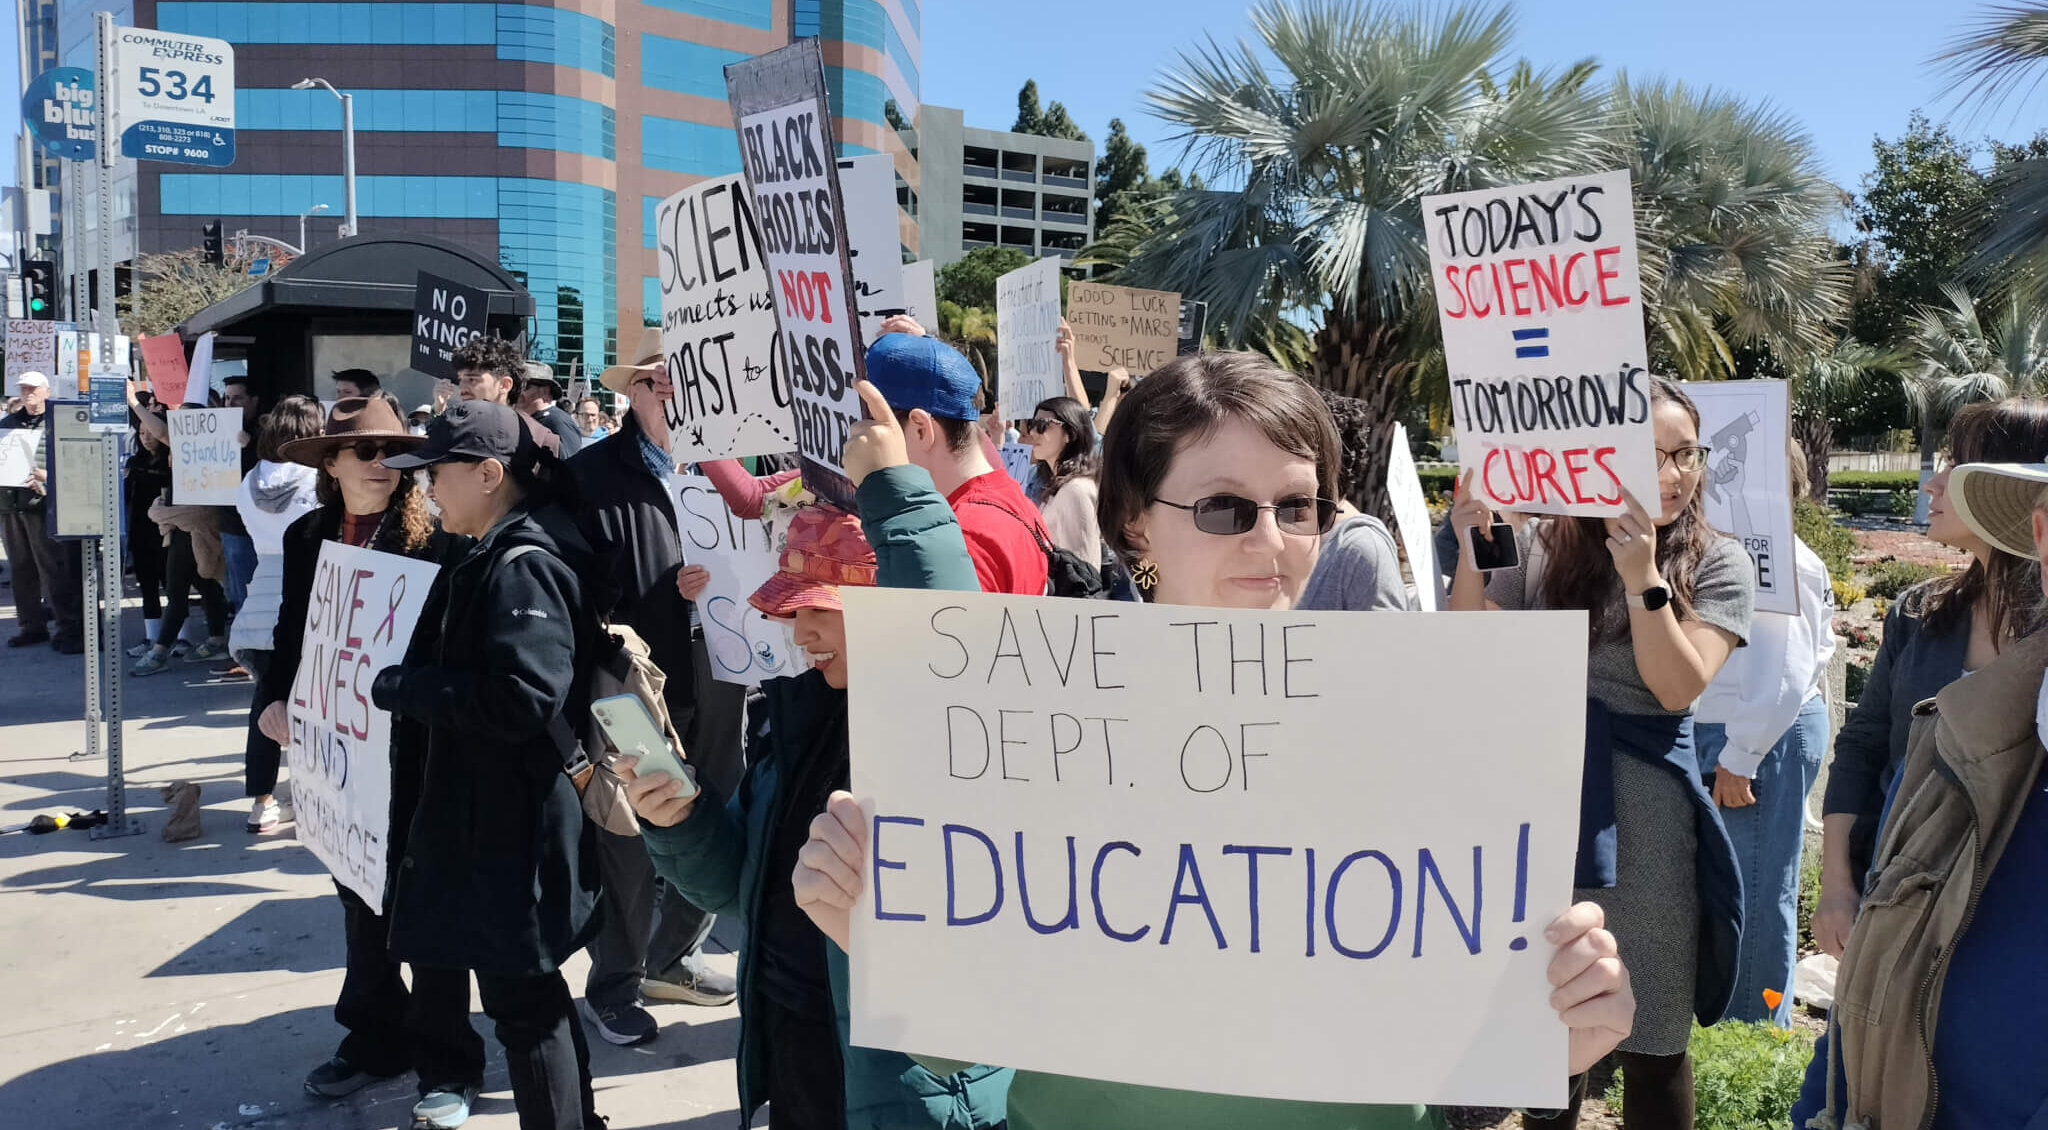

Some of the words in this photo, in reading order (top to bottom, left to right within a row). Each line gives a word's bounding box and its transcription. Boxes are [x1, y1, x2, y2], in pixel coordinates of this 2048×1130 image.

[122, 34, 204, 53] COMMUTER
[152, 47, 224, 65] EXPRESS
[55, 82, 93, 108] big
[137, 66, 216, 104] 534
[66, 123, 96, 141] bus
[743, 111, 824, 185] BLACK
[144, 144, 179, 156] STOP#
[183, 147, 209, 159] 9600
[659, 179, 768, 296] SCIEN
[756, 188, 836, 255] HOLES
[1434, 184, 1606, 258] TODAY'S
[777, 268, 833, 324] NOT
[1444, 245, 1631, 320] SCIENCE
[432, 288, 467, 321] NO
[750, 289, 774, 311] us
[1072, 285, 1115, 306] GOOD
[1130, 292, 1168, 315] LUCK
[8, 321, 54, 334] SCIENCE
[1068, 310, 1117, 328] GETTING
[1130, 315, 1172, 338] MARS
[1075, 333, 1109, 345] ITHOUT
[8, 337, 50, 351] MAKES
[419, 343, 430, 356] IN
[439, 348, 454, 362] THE
[1098, 345, 1167, 371] SCIENCE
[742, 356, 768, 384] to
[788, 330, 855, 403] ASS-
[1453, 362, 1650, 434] TOMORROW'S
[172, 411, 217, 437] NEURO
[794, 396, 858, 469] HOLE
[181, 437, 218, 465] Stand
[220, 438, 237, 468] Up
[1482, 446, 1624, 507] CURES
[1744, 538, 1769, 552] FOR
[310, 560, 375, 650] SAVE
[927, 604, 1126, 691] SAVE
[1169, 620, 1320, 699] THE
[293, 632, 373, 742] LIVES
[292, 715, 349, 792] FUND
[945, 705, 1135, 788] DEPT.
[1179, 721, 1281, 794] OF
[872, 814, 1532, 962] EDUCATION!
